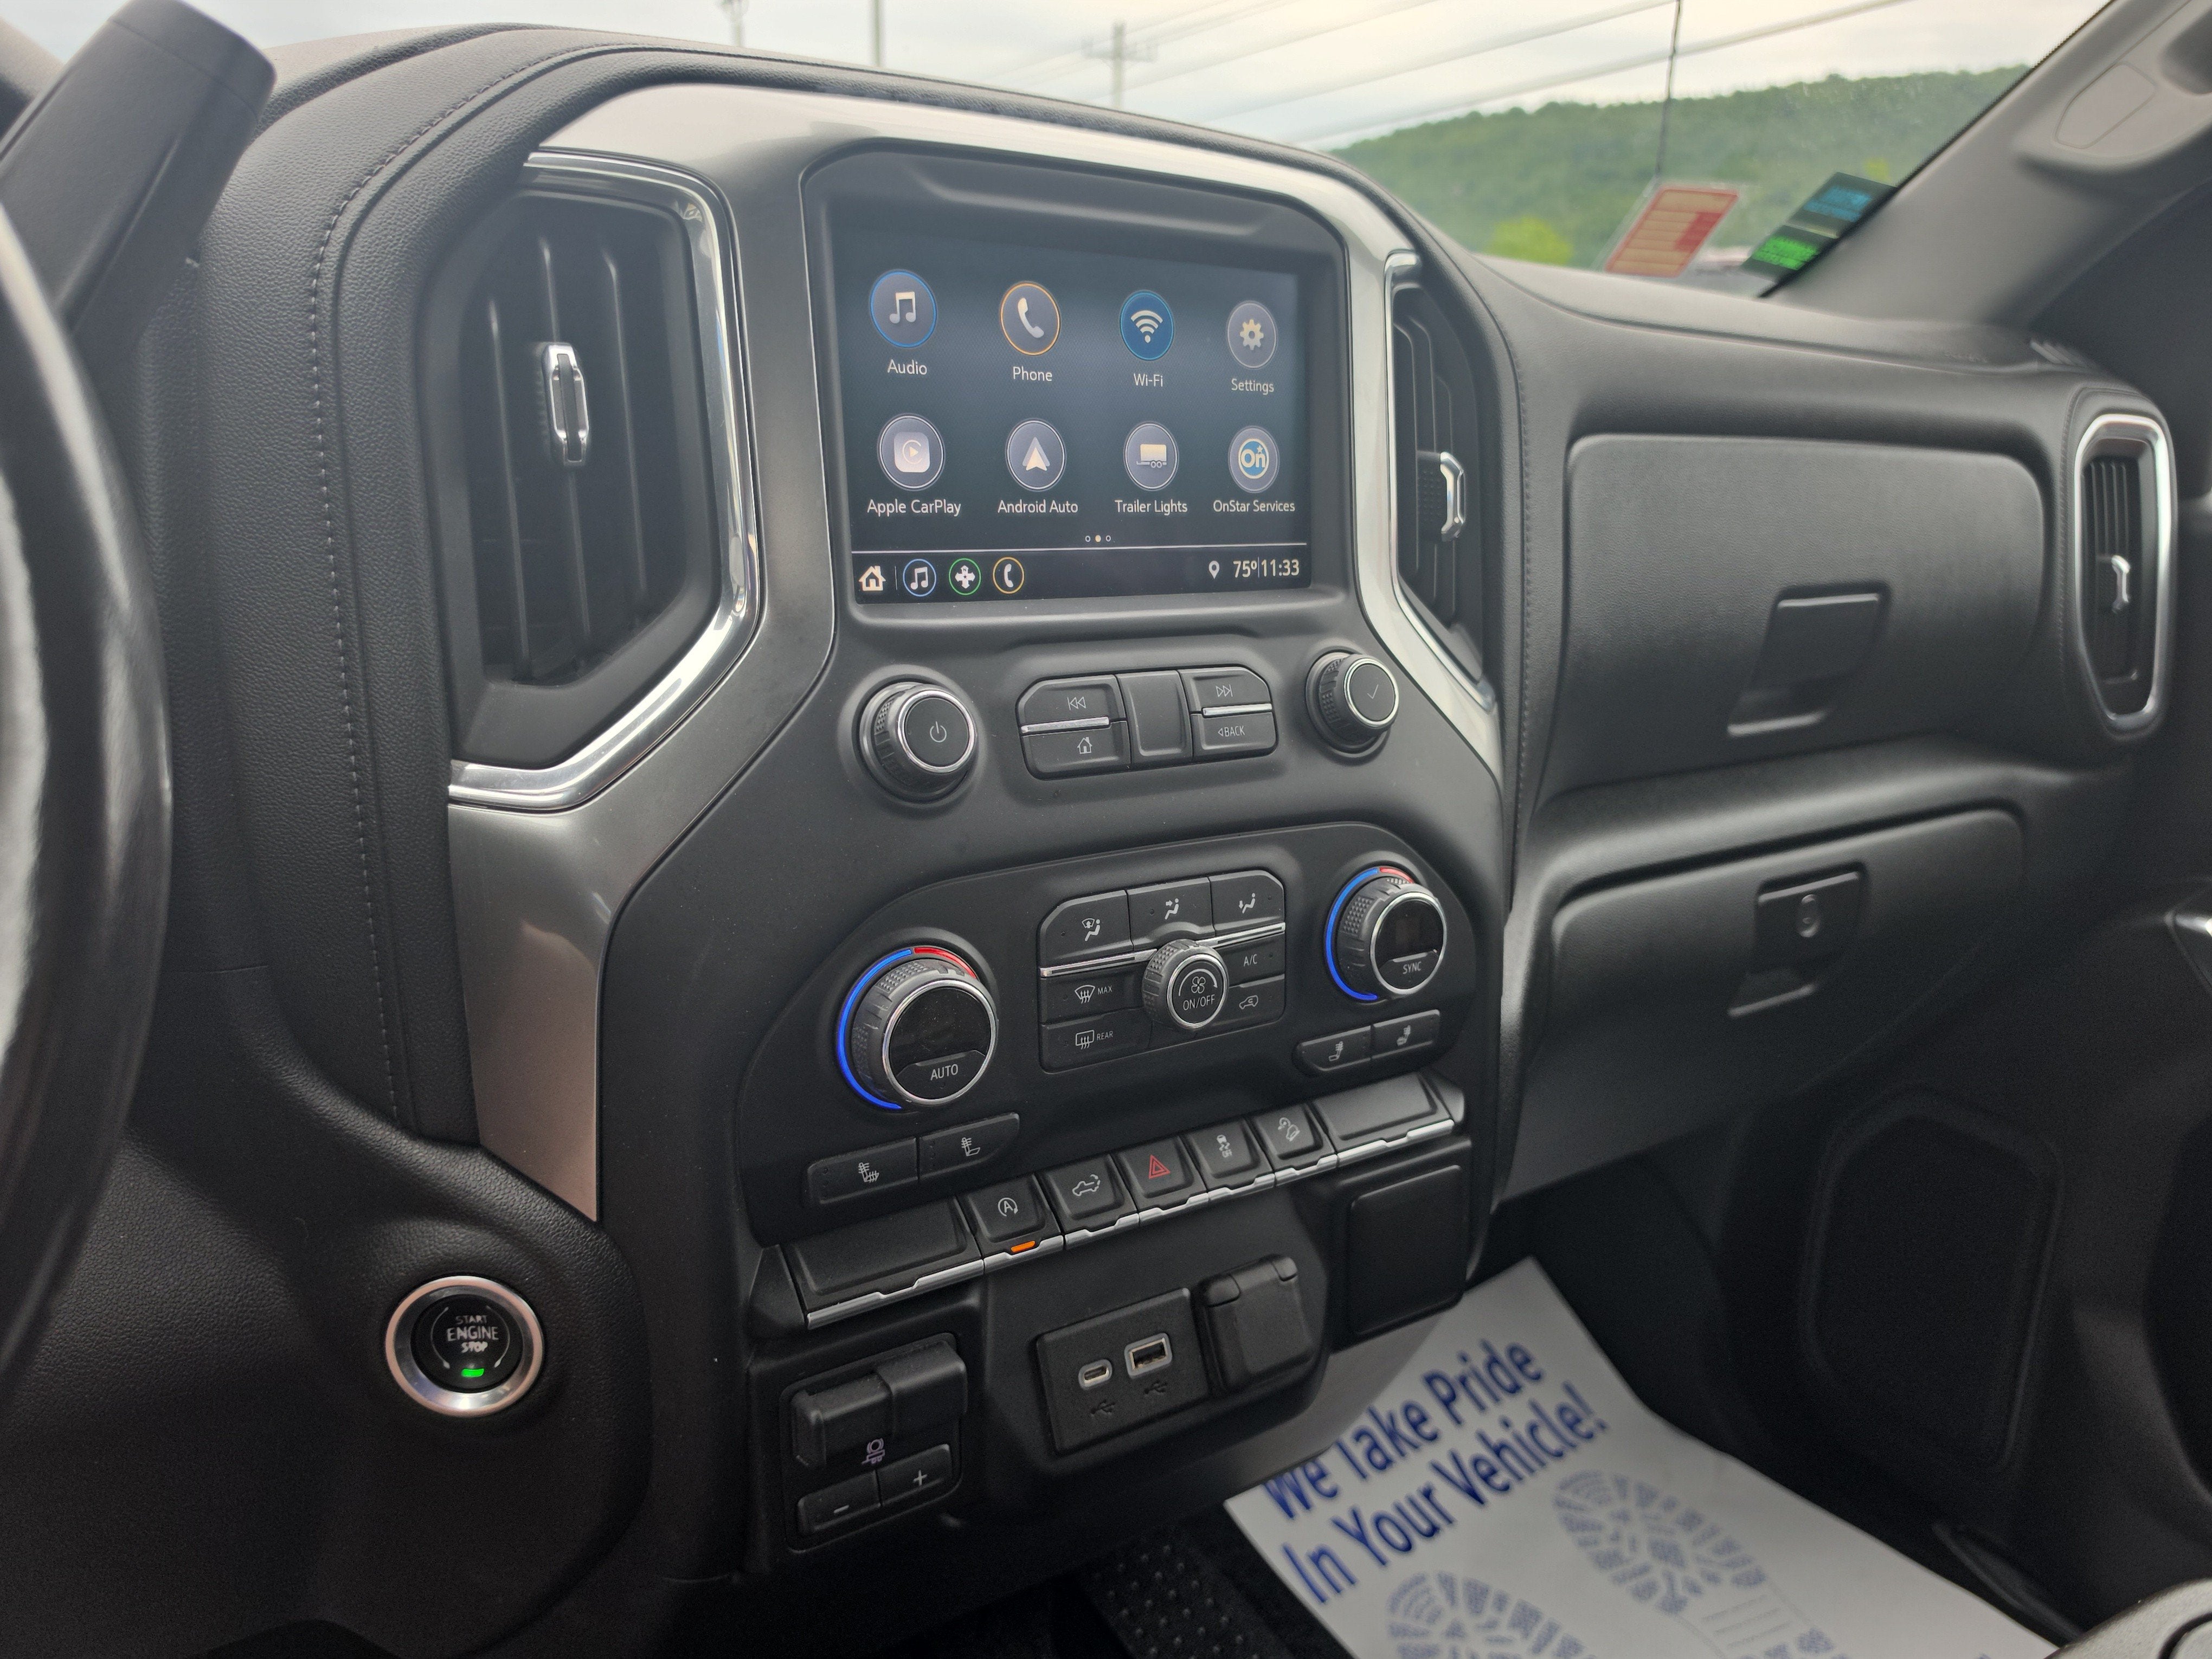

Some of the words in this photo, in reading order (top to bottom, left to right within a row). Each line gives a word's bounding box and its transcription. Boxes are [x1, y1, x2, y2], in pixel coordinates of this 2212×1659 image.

[888, 359, 927, 375] Audio
[1013, 366, 1052, 382] Phone
[1134, 373, 1163, 387] Wi-Fi
[1231, 378, 1274, 395] Settings
[867, 499, 906, 517] Apple
[911, 499, 961, 517] CarPlay
[998, 500, 1046, 513] Android
[1049, 500, 1079, 513] Auto
[1115, 499, 1151, 513] Trailer
[1154, 499, 1188, 516] Lights
[1213, 499, 1250, 512] OnStar
[1252, 499, 1296, 512] Services
[1261, 559, 1300, 577] 11:33
[1224, 725, 1245, 737] BACK
[1243, 954, 1258, 967] A/C
[1403, 961, 1422, 974] SYNC
[1097, 985, 1113, 995] MAX
[1183, 994, 1216, 1011] ON/OFF
[1096, 1031, 1113, 1041] REAR
[930, 1064, 959, 1081] AUTO
[455, 1315, 488, 1324] START
[446, 1325, 499, 1342] ENGINE
[461, 1341, 488, 1353] STOP
[1262, 1458, 1339, 1520] We
[1423, 1338, 1544, 1427] Pride
[1281, 1541, 1358, 1605] In
[1330, 1484, 1457, 1567] Your
[1429, 1380, 1611, 1507] Vehicle!
